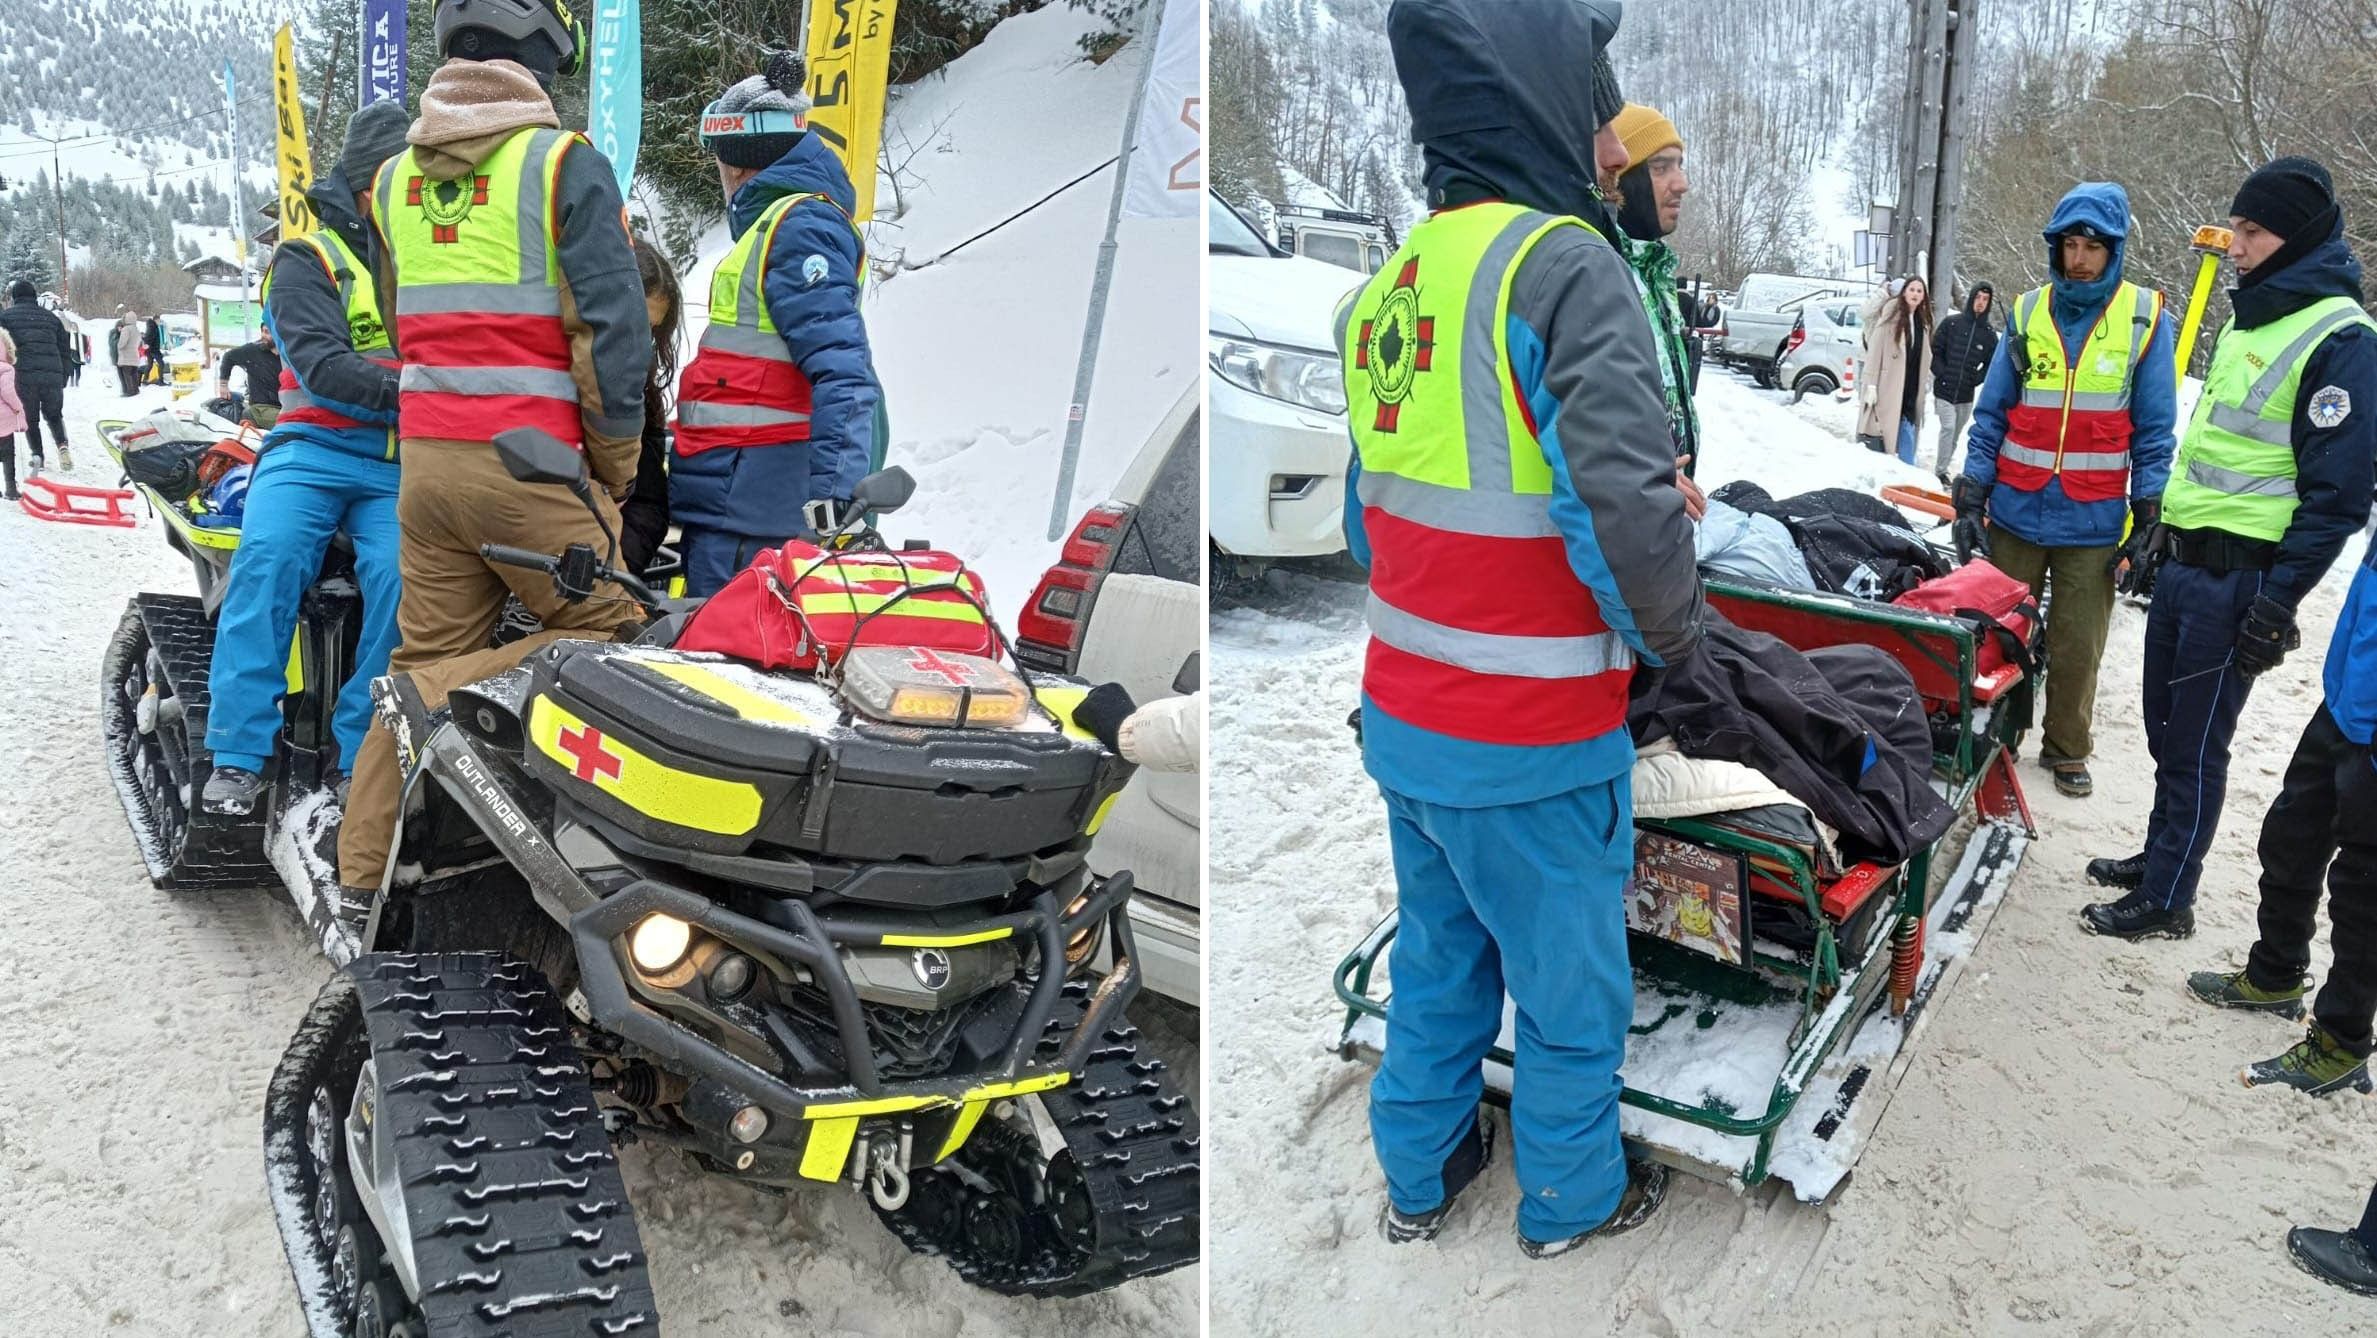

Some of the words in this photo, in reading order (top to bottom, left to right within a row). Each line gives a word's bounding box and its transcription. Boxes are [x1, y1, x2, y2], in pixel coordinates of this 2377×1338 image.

[862, 10, 884, 39] by
[703, 115, 746, 132] uvex
[285, 152, 309, 233] Ski
[455, 755, 526, 837] OUTLANDER
[930, 966, 948, 974] BRP
